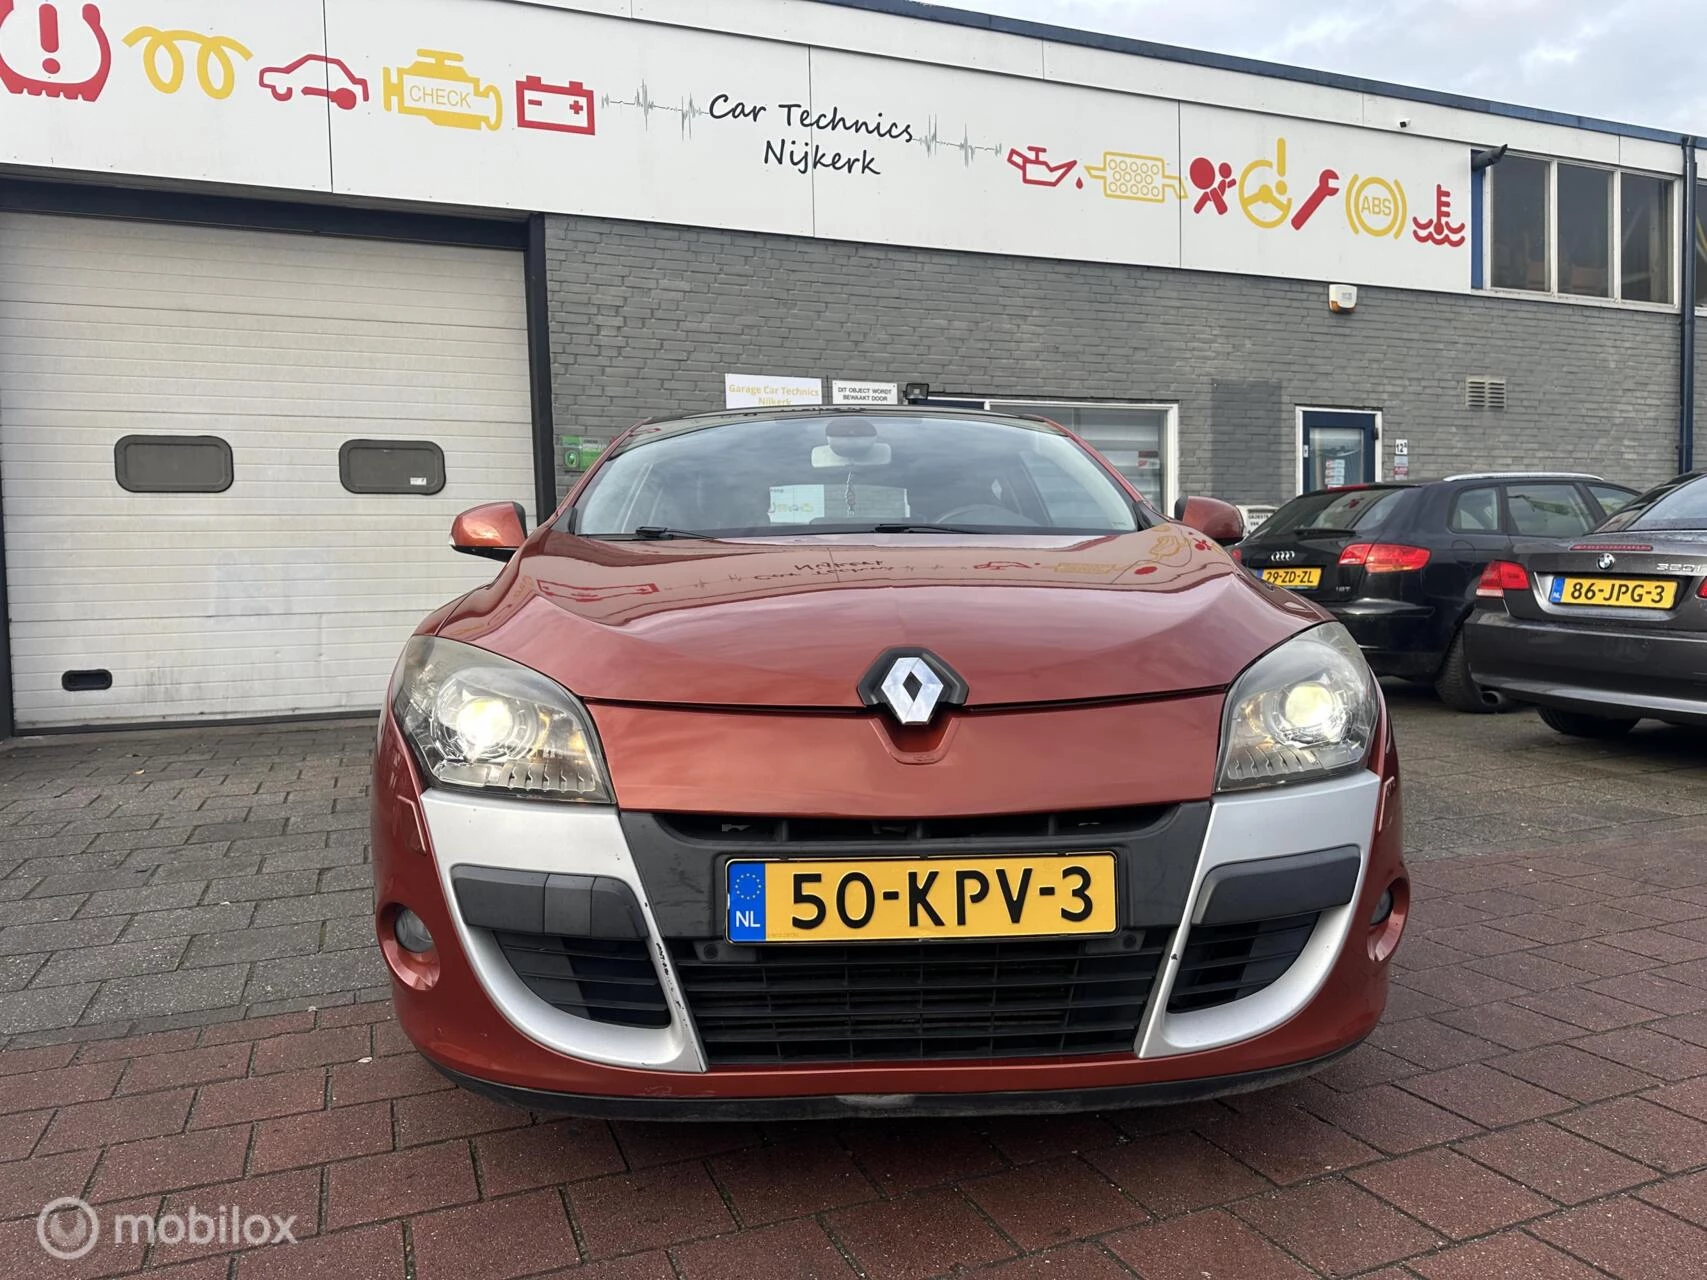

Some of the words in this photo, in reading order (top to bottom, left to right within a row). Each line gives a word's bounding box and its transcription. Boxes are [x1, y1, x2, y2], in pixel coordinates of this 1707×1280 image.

[409, 84, 472, 109] CHECK
[708, 93, 767, 122] Car
[778, 103, 913, 143] Technics
[763, 138, 882, 176] Nijkerk
[1361, 196, 1392, 217] ABS
[728, 384, 761, 396] Garage
[763, 386, 779, 395] Car
[780, 386, 820, 397] Technics
[1266, 570, 1314, 584] 29-ZD-ZL
[1570, 582, 1665, 604] 86-JPG-3
[735, 910, 761, 928] NL
[791, 865, 1094, 930] 50-KPV-3
